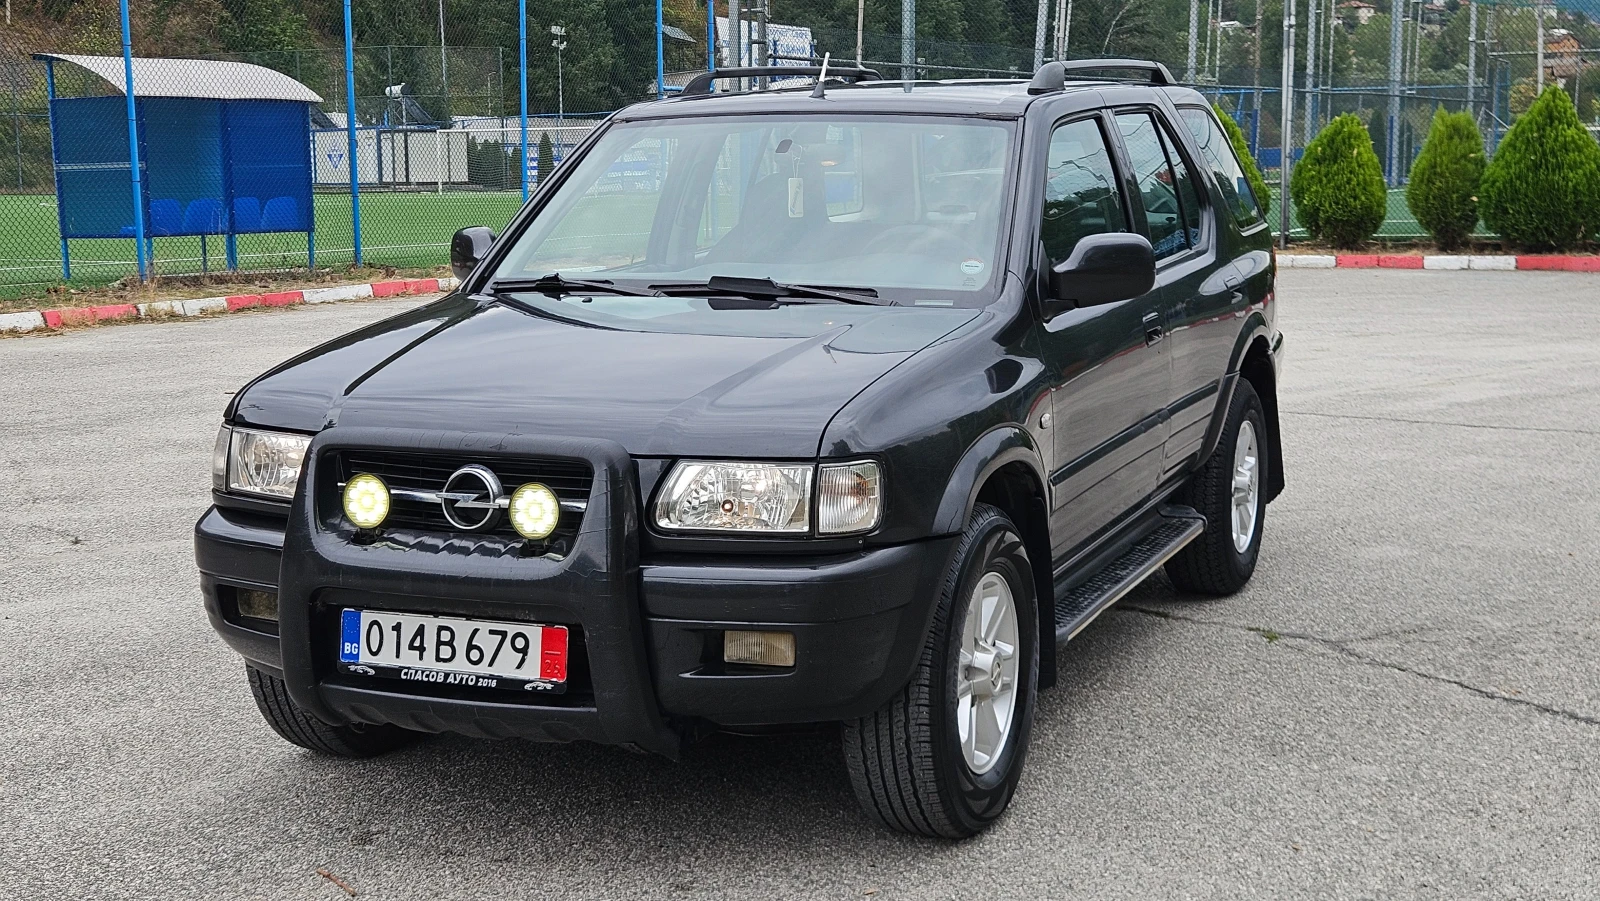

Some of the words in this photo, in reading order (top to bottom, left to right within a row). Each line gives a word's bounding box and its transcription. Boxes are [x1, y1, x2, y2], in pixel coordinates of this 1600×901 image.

[344, 643, 359, 655] BG
[400, 668, 445, 683] СПАСОВ
[446, 673, 476, 686] АУТО
[477, 677, 498, 688] 2016
